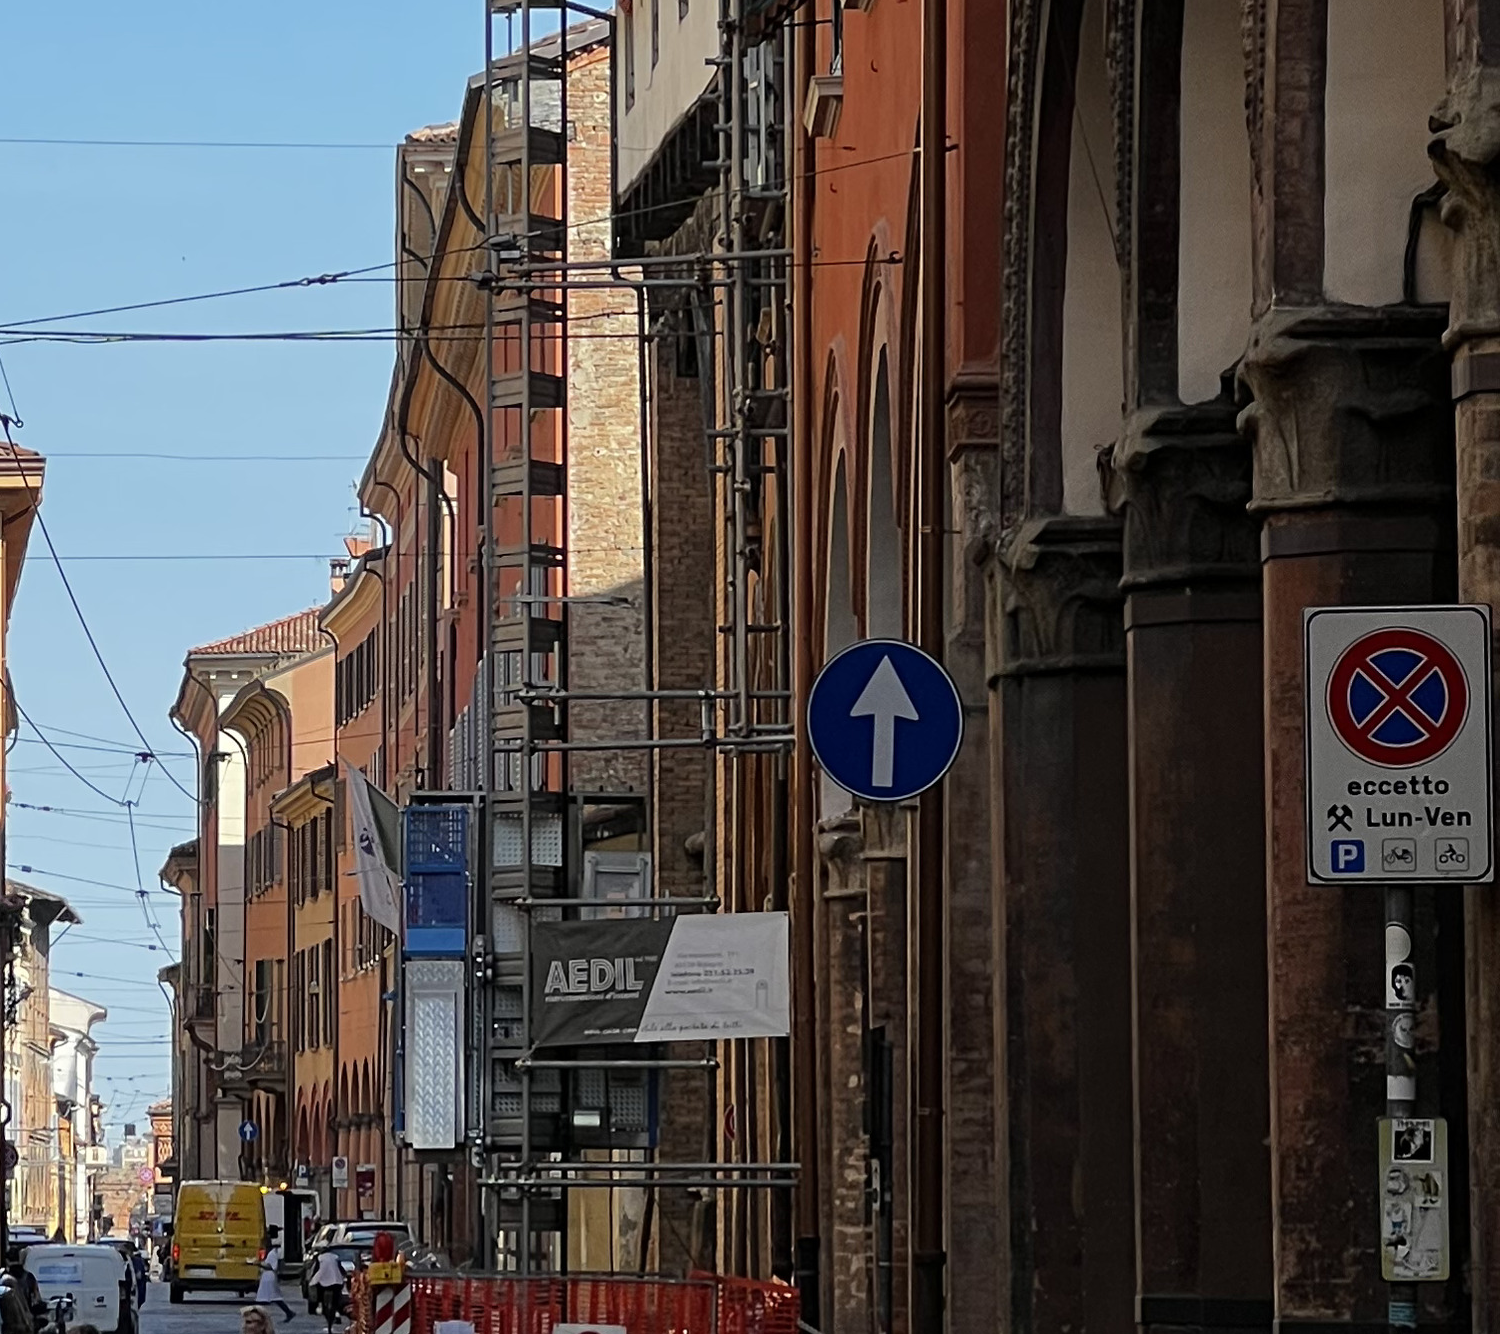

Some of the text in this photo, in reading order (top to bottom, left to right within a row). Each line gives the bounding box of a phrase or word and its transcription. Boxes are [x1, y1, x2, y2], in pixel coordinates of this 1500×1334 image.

[1347, 775, 1450, 796] eccetto
[1365, 806, 1472, 828] Lun-Ven
[1337, 844, 1358, 870] P
[544, 957, 645, 995] AEDIL
